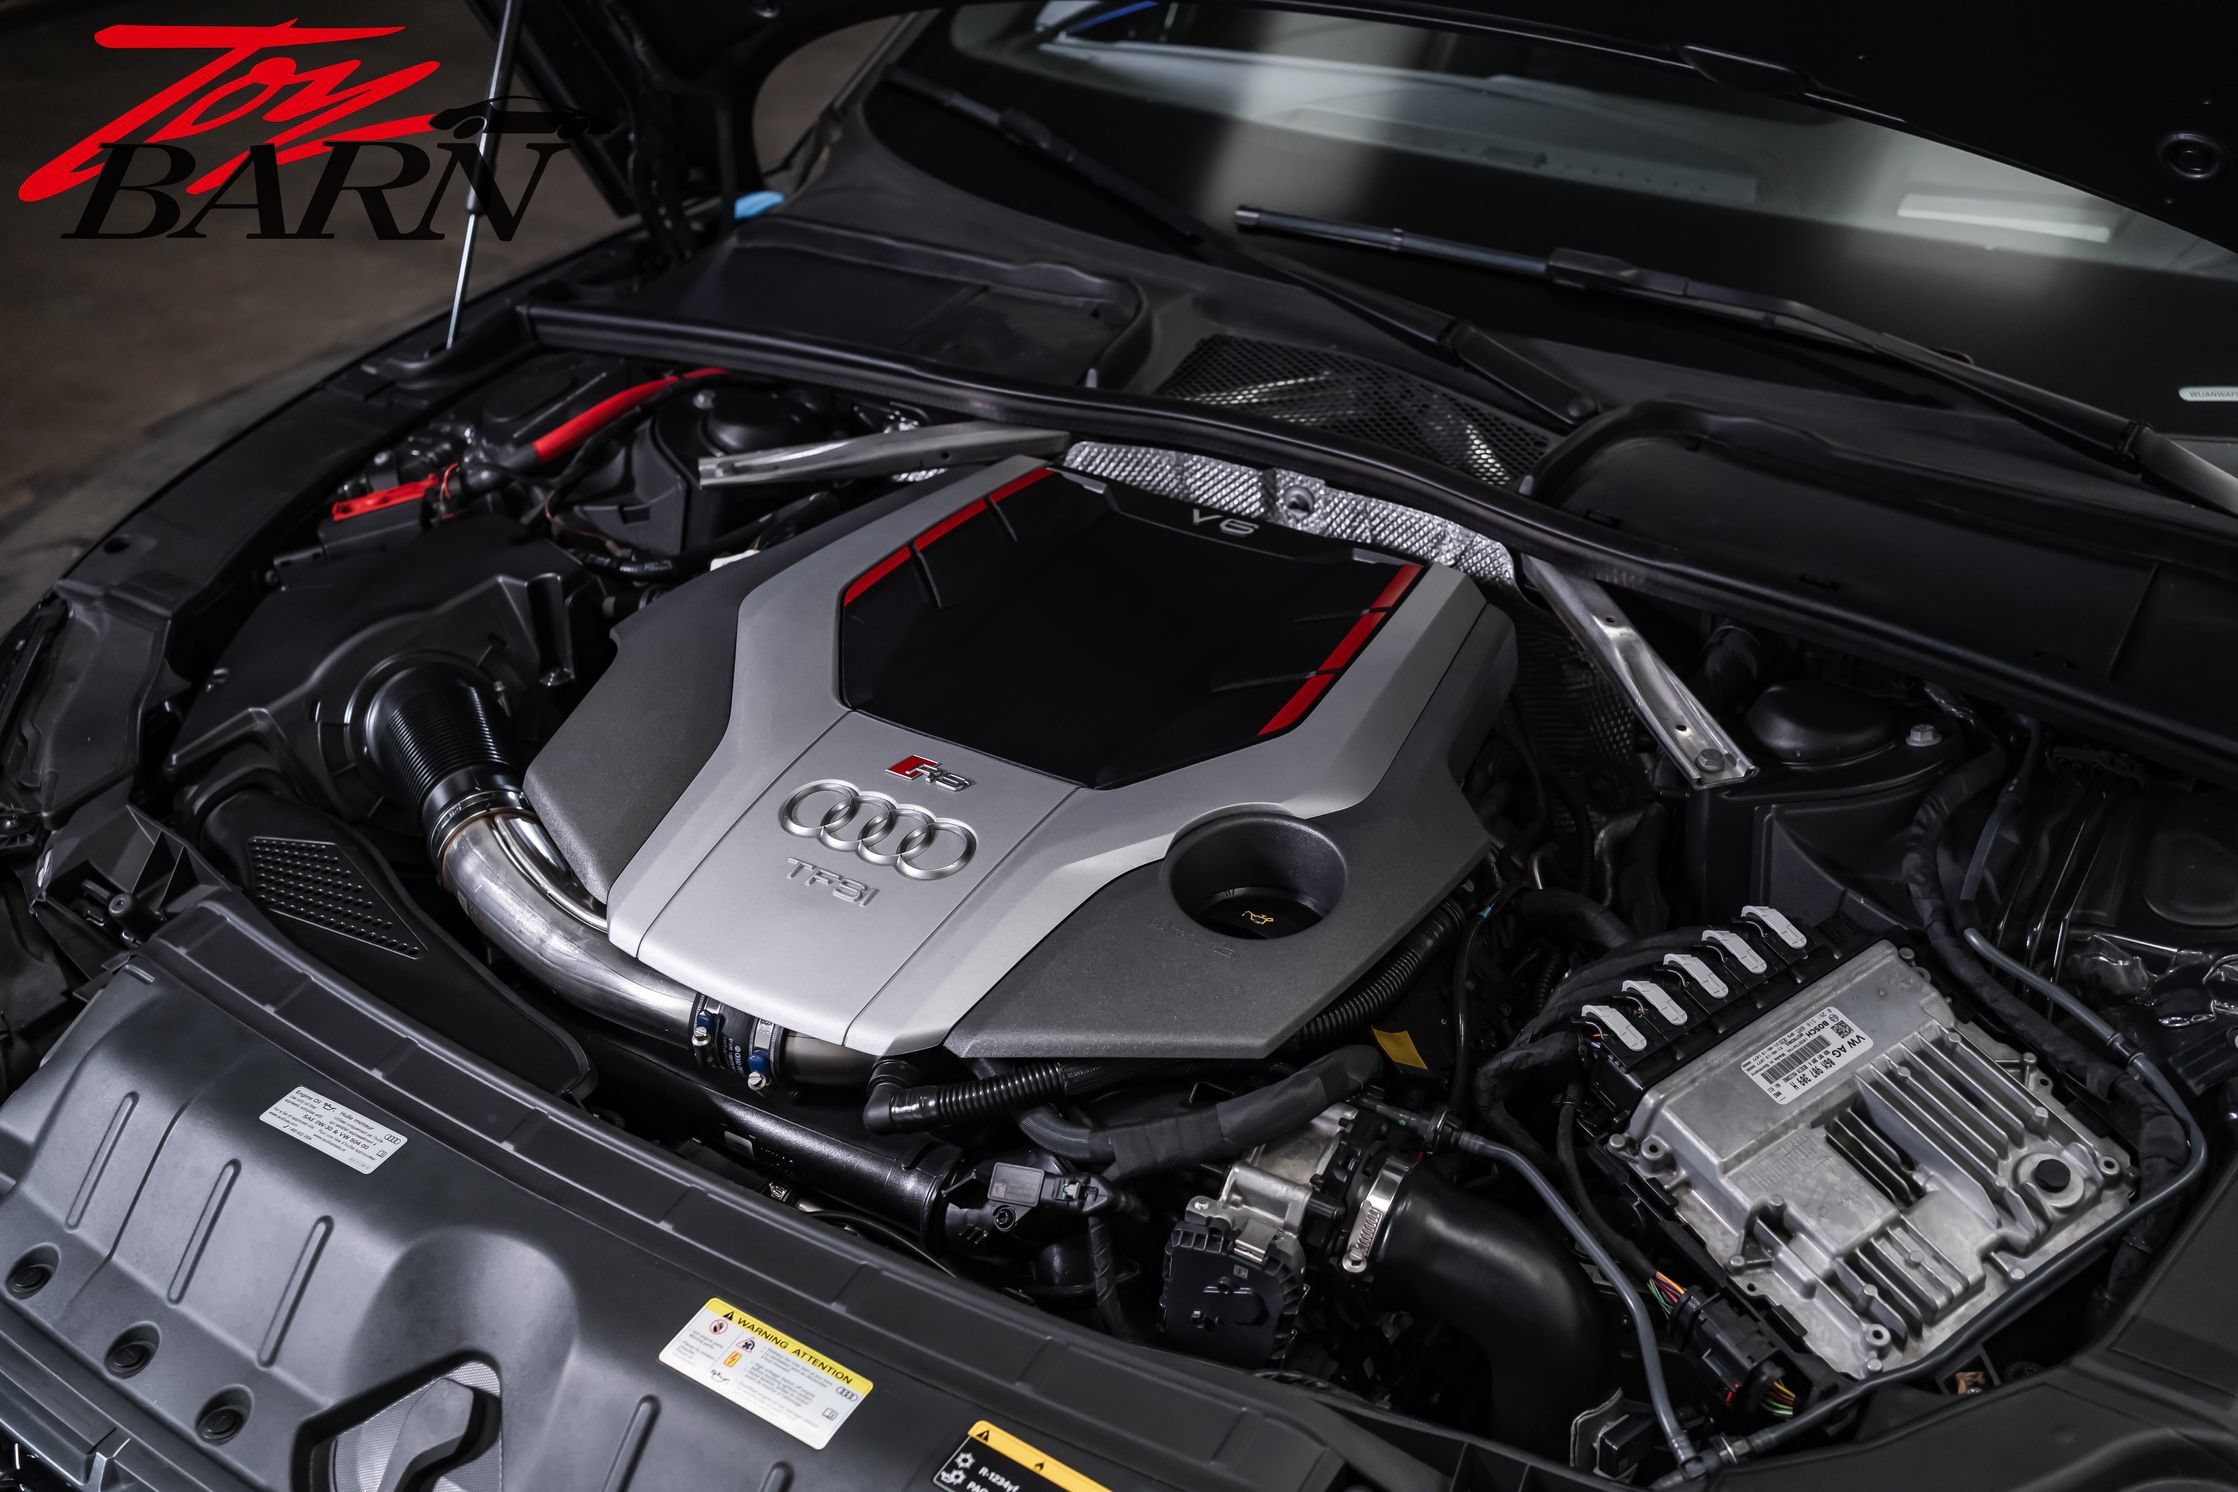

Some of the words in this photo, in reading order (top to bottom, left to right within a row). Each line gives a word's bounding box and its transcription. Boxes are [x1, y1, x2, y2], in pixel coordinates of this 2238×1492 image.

[1192, 508, 1259, 536] V6
[885, 754, 974, 792] RS
[786, 856, 880, 907] TFSI
[1806, 1020, 1830, 1038] BOSCH
[1832, 1044, 1848, 1058] AG
[1848, 1034, 1866, 1049] VW
[1798, 1073, 1812, 1086] 309
[1810, 1065, 1824, 1079] 907
[295, 1089, 313, 1101] Engine
[302, 1114, 316, 1123] SAE
[339, 1132, 351, 1141] VW
[339, 1111, 354, 1121] Huile
[353, 1118, 375, 1131] moteur
[737, 1317, 789, 1350] WARNING
[791, 1348, 853, 1385] ATTENTION
